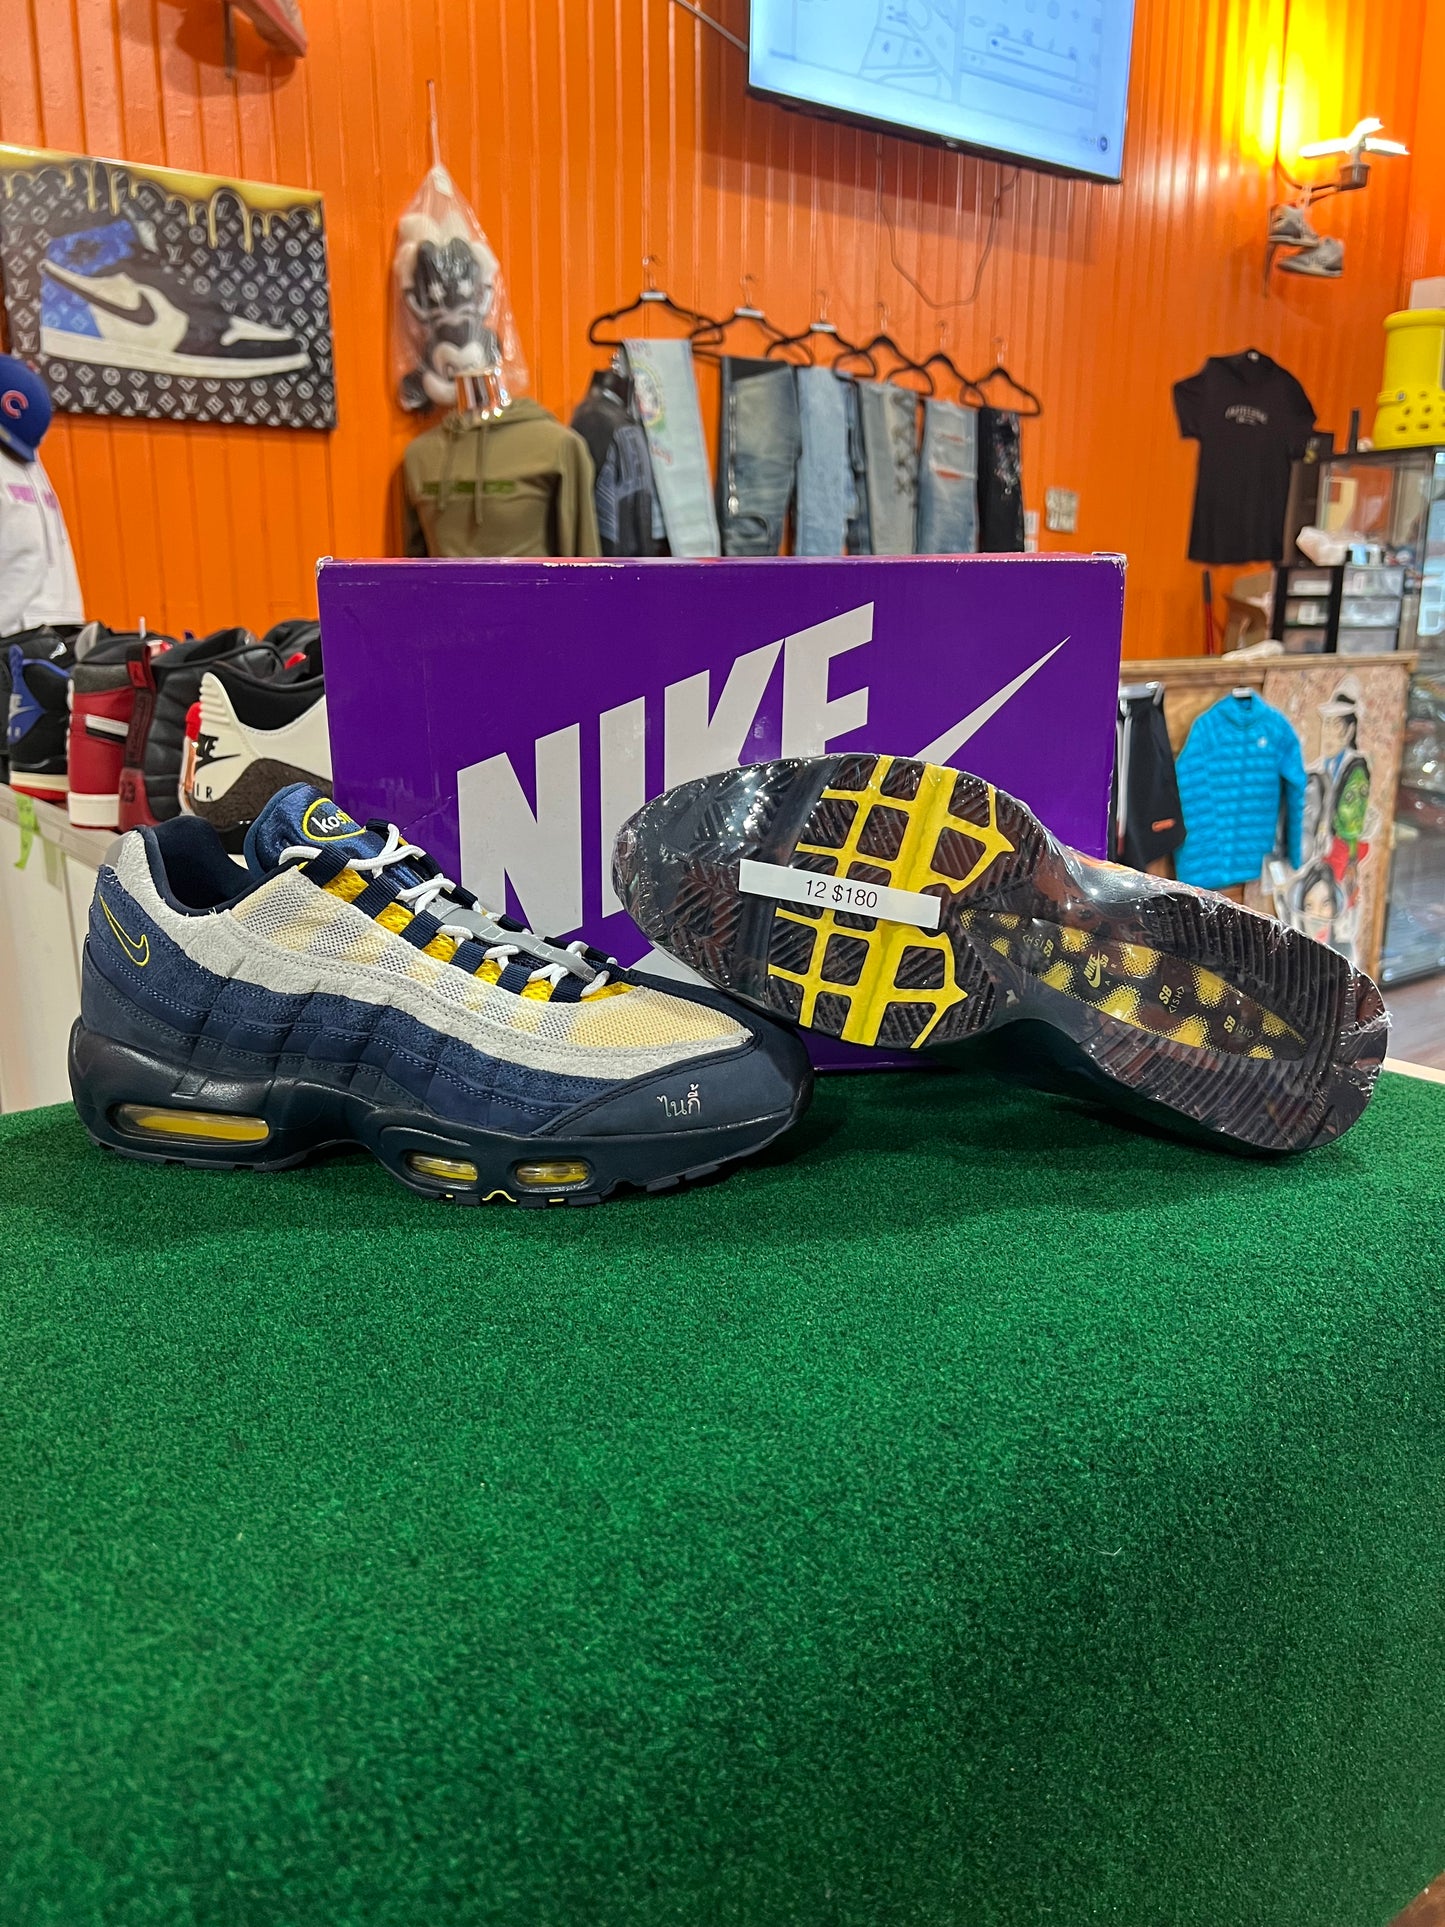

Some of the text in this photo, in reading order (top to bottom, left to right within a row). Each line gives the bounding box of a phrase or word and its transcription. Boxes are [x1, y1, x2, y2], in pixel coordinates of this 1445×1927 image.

[457, 601, 874, 938] NIKE
[806, 880, 878, 909] 12 $180
[1083, 953, 1098, 980] NIKE
[1158, 984, 1172, 1005] SB
[1223, 1015, 1236, 1033] SB
